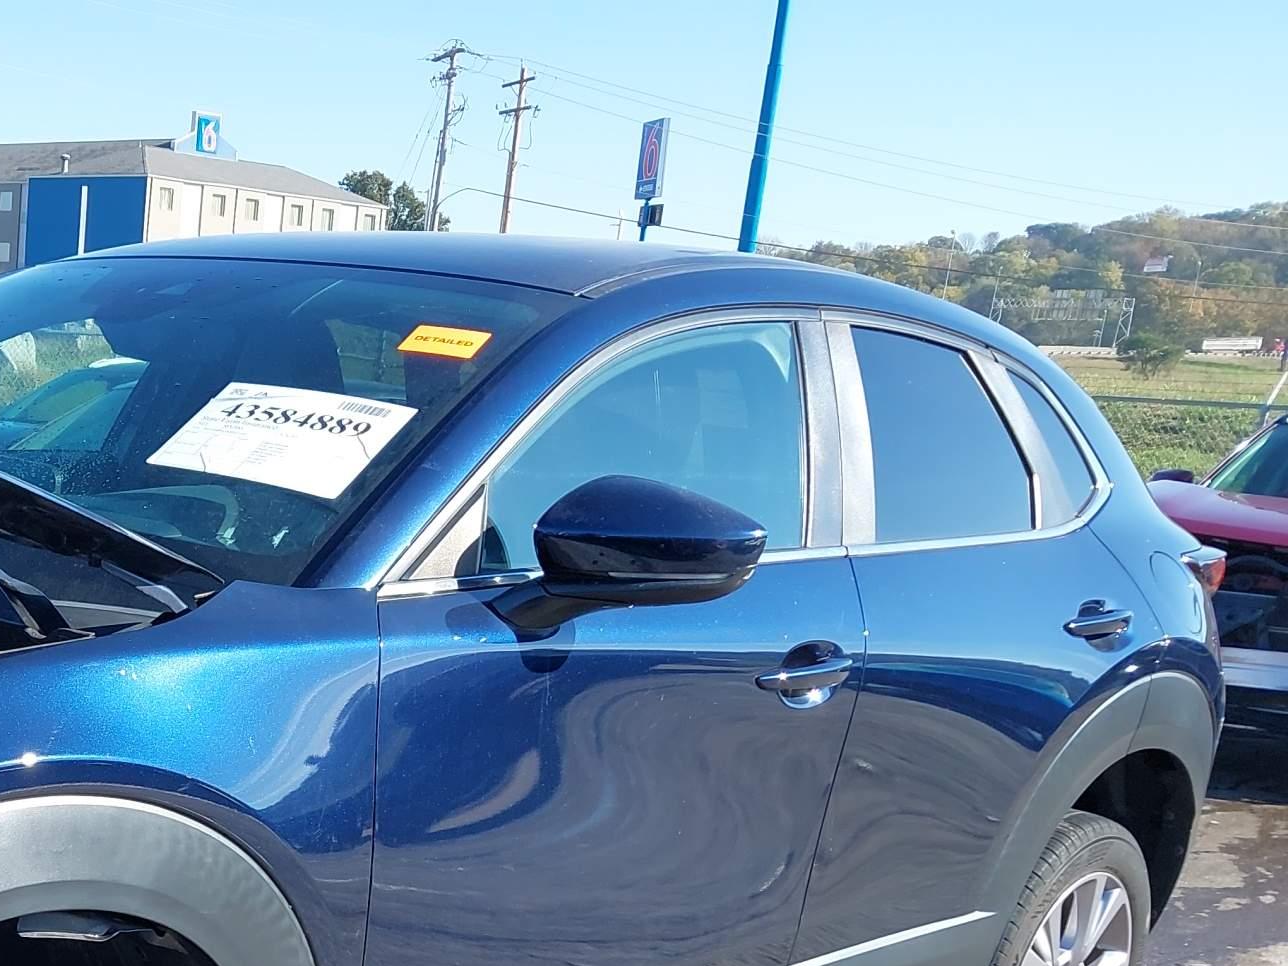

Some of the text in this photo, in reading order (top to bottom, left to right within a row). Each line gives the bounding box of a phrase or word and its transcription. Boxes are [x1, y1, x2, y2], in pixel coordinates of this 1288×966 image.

[201, 119, 218, 153] 6
[642, 121, 660, 181] 6
[414, 335, 474, 347] DETAILED
[221, 402, 372, 437] 43584889
